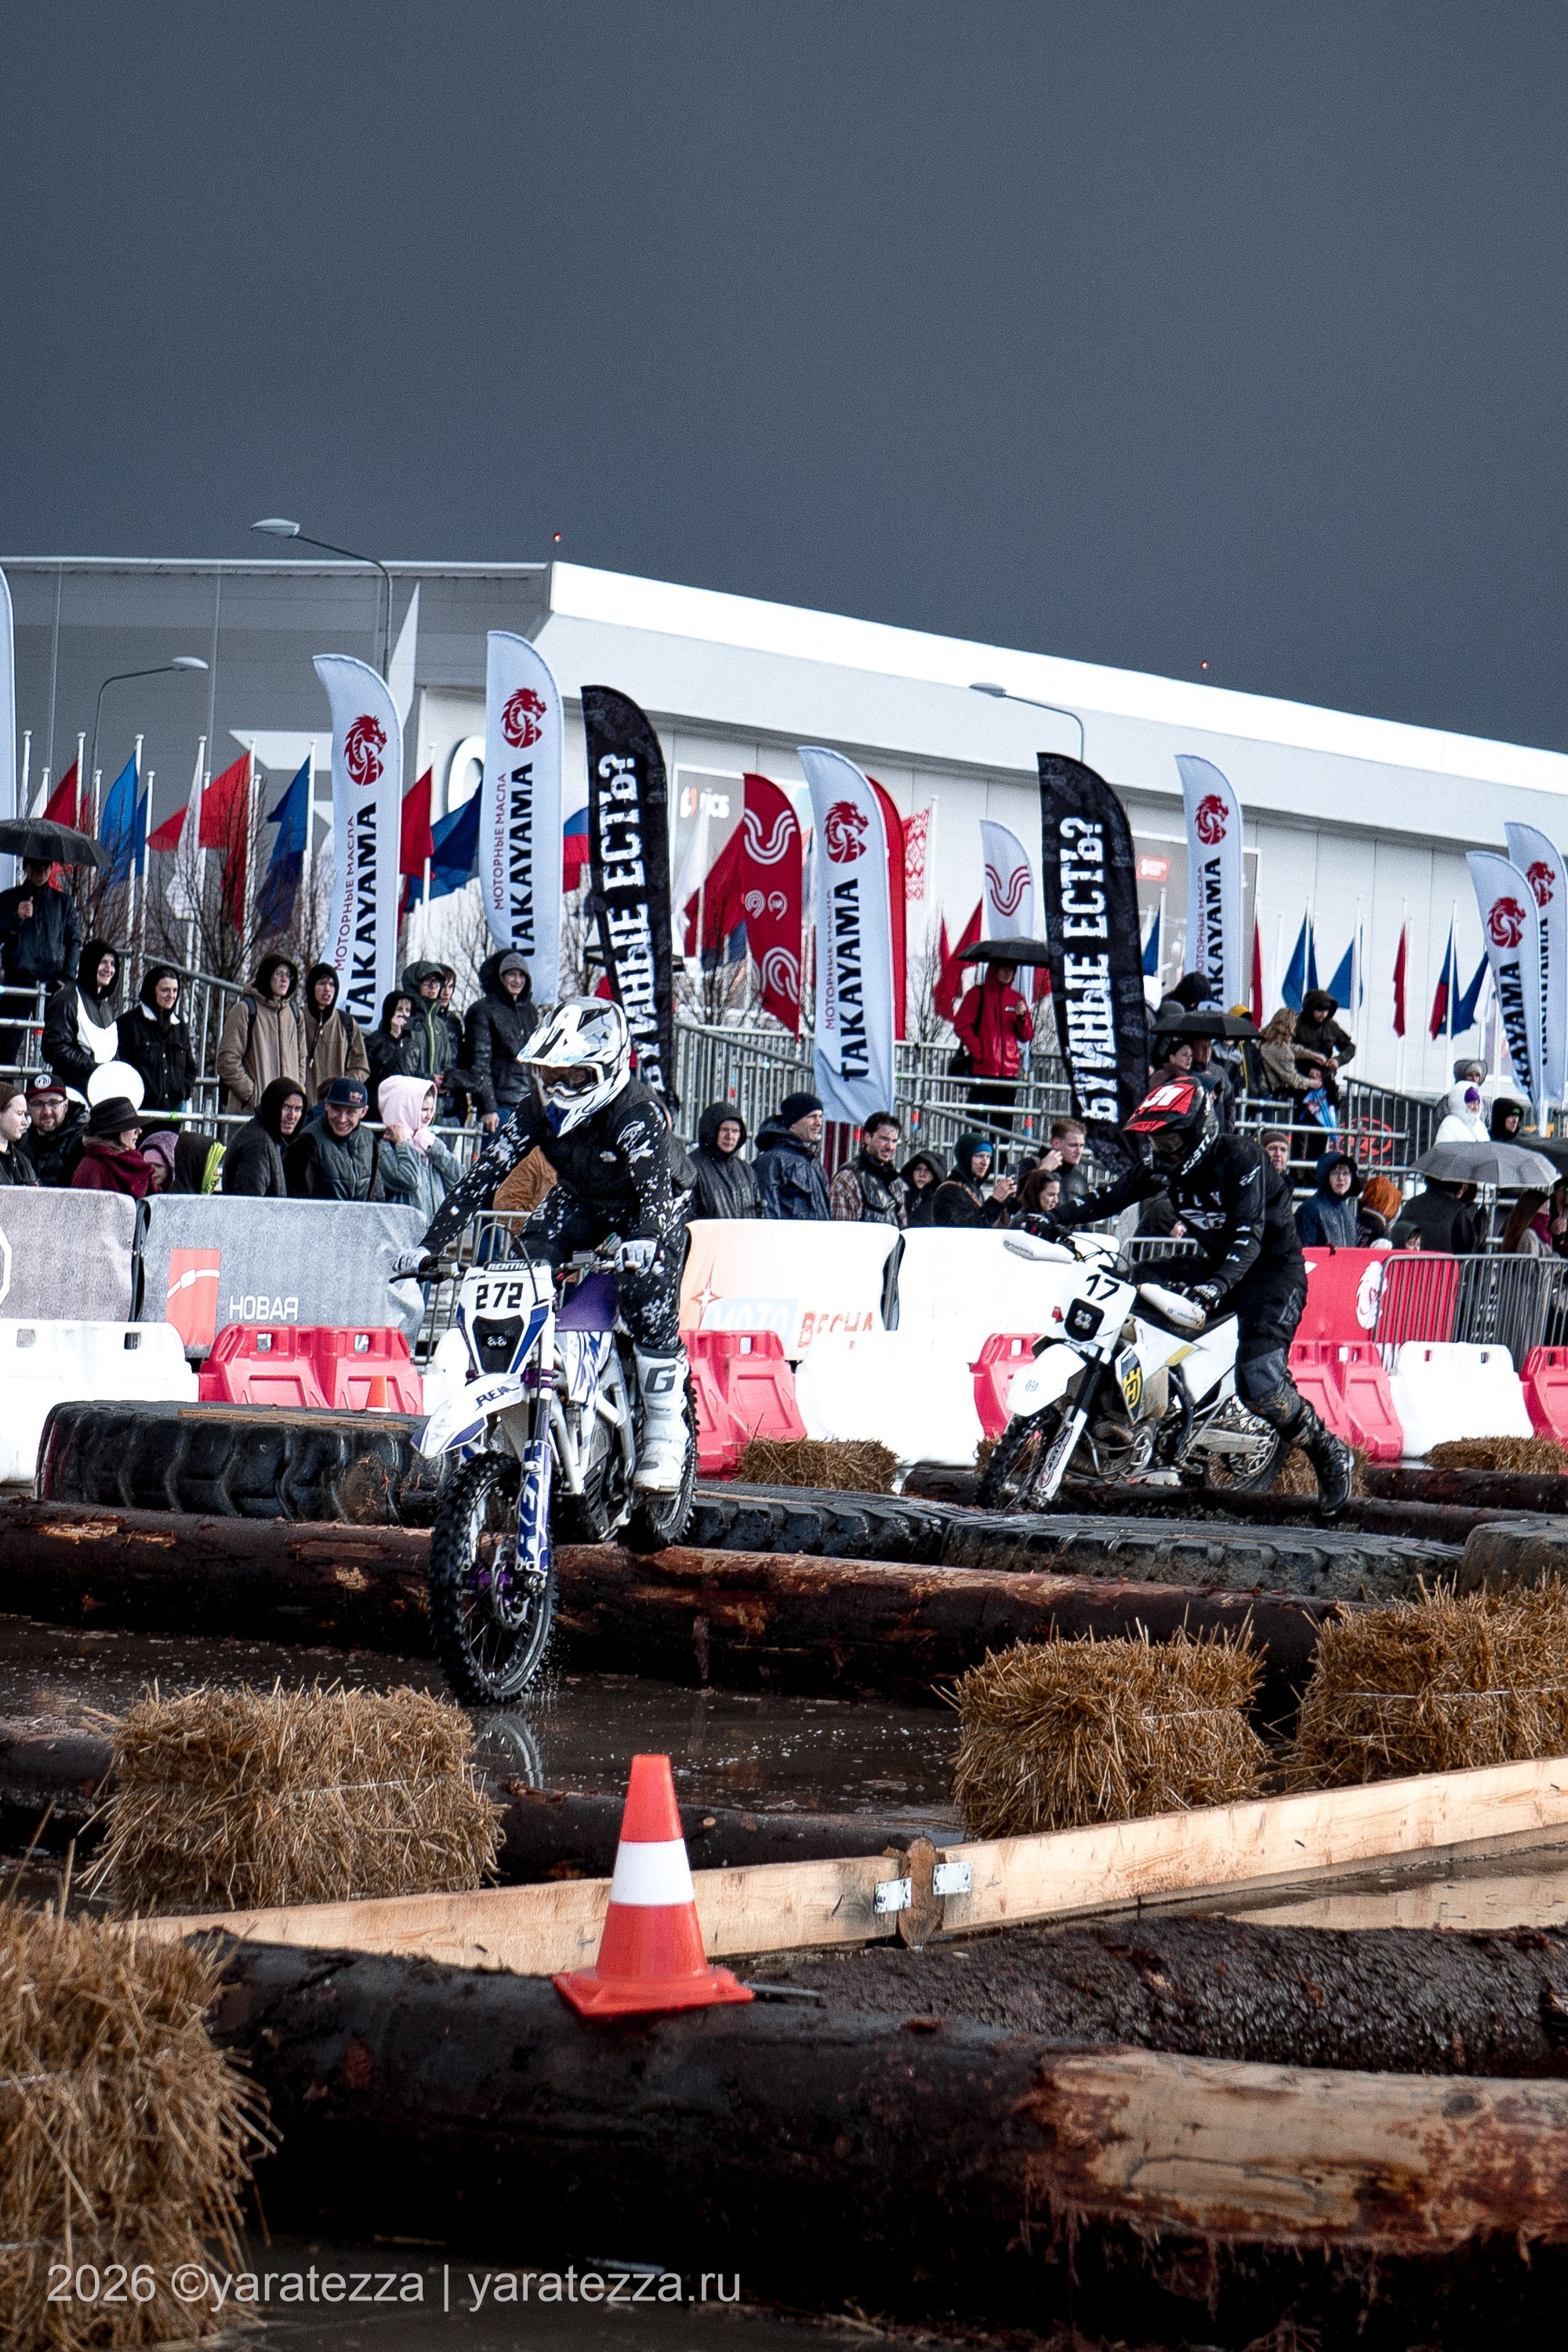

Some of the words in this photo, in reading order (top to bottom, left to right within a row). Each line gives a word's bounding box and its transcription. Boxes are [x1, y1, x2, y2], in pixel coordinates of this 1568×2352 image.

[495, 773, 506, 825] МАСЛА
[598, 753, 646, 892] ЕСТЬ?
[493, 829, 506, 910] МОТОРНЫЕ
[1059, 817, 1109, 939] ЕСТЬ?
[334, 879, 354, 971] МОТОРНЫЕ
[1196, 913, 1205, 973] ОТОРНЫЕ
[1204, 857, 1224, 1007] AKAYAMA
[834, 877, 869, 1082] TAKAYAMA
[229, 1295, 299, 1321] НОВАЯ
[476, 1282, 524, 1310] 272
[1085, 1273, 1120, 1301] 17
